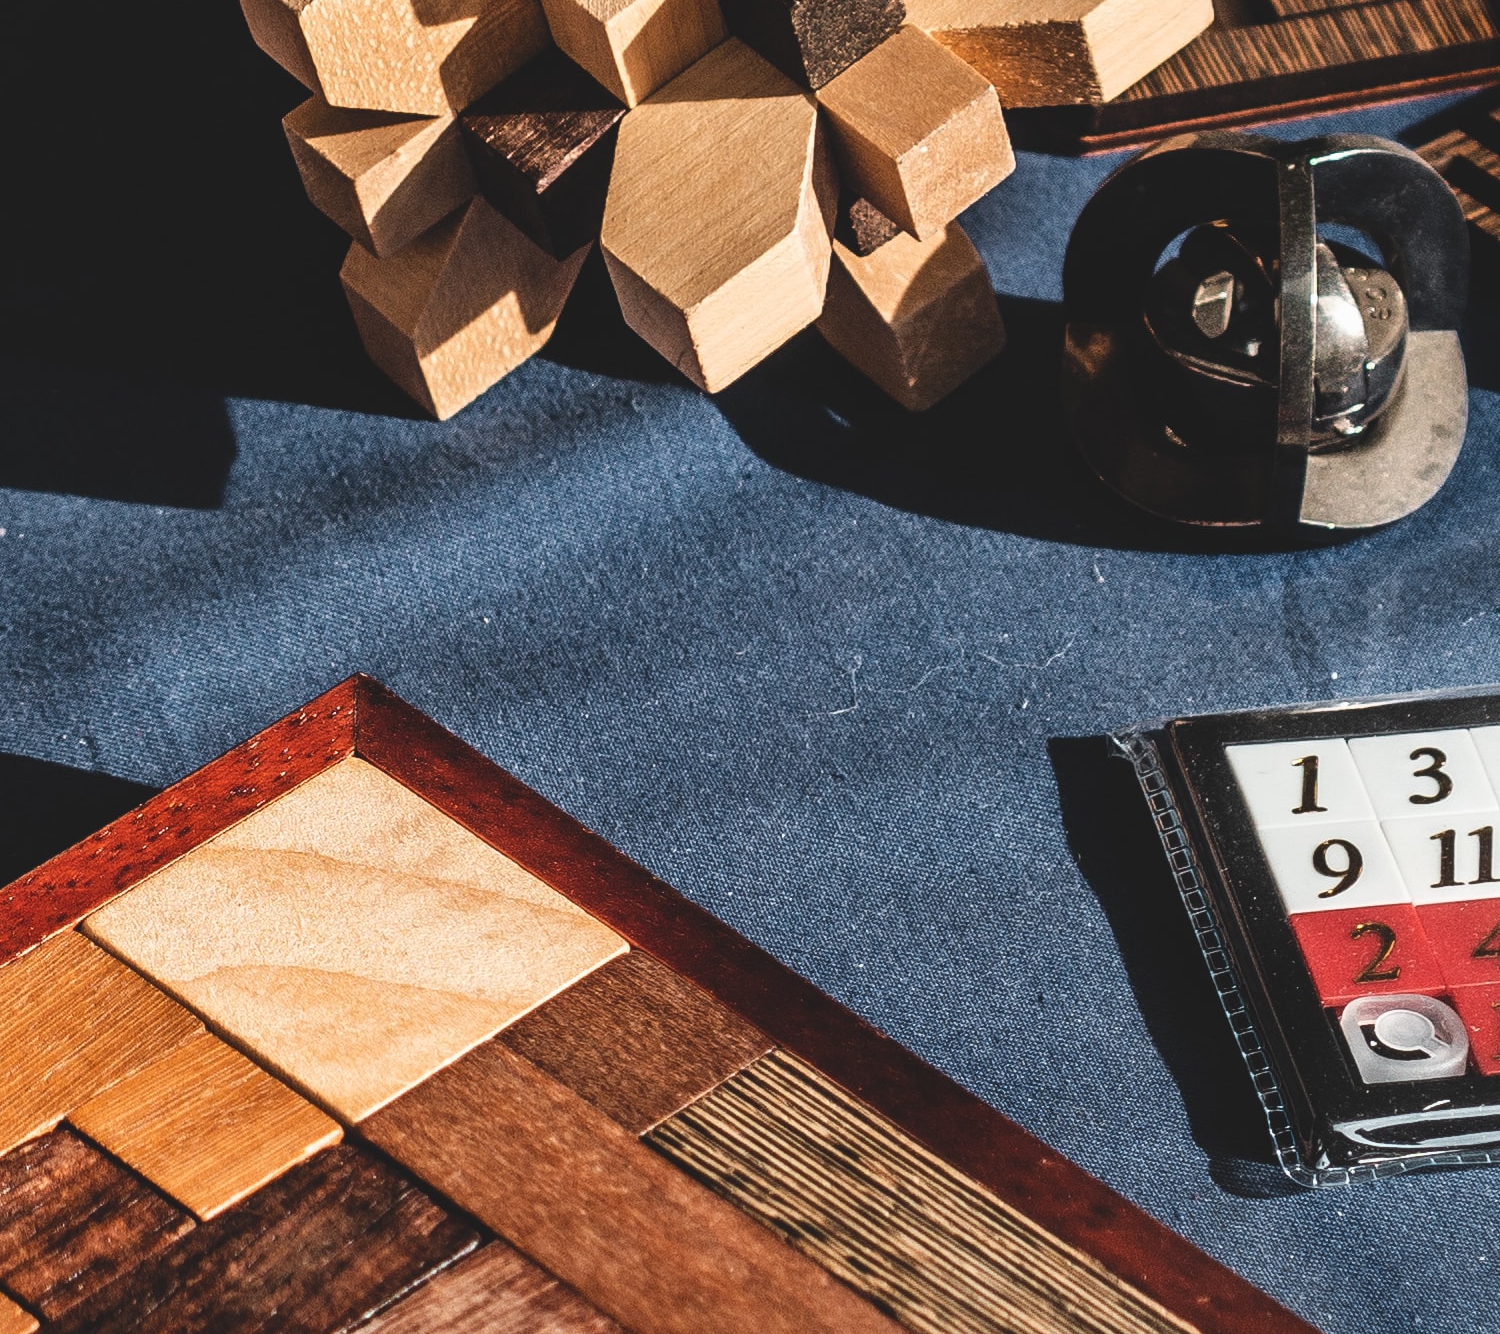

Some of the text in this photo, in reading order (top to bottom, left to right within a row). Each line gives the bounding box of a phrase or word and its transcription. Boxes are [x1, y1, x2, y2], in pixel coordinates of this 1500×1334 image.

[1292, 756, 1326, 814] 1
[1410, 748, 1451, 804] 3
[1313, 840, 1362, 898] 9
[1431, 827, 1500, 888] 11
[1348, 921, 1403, 986] 2
